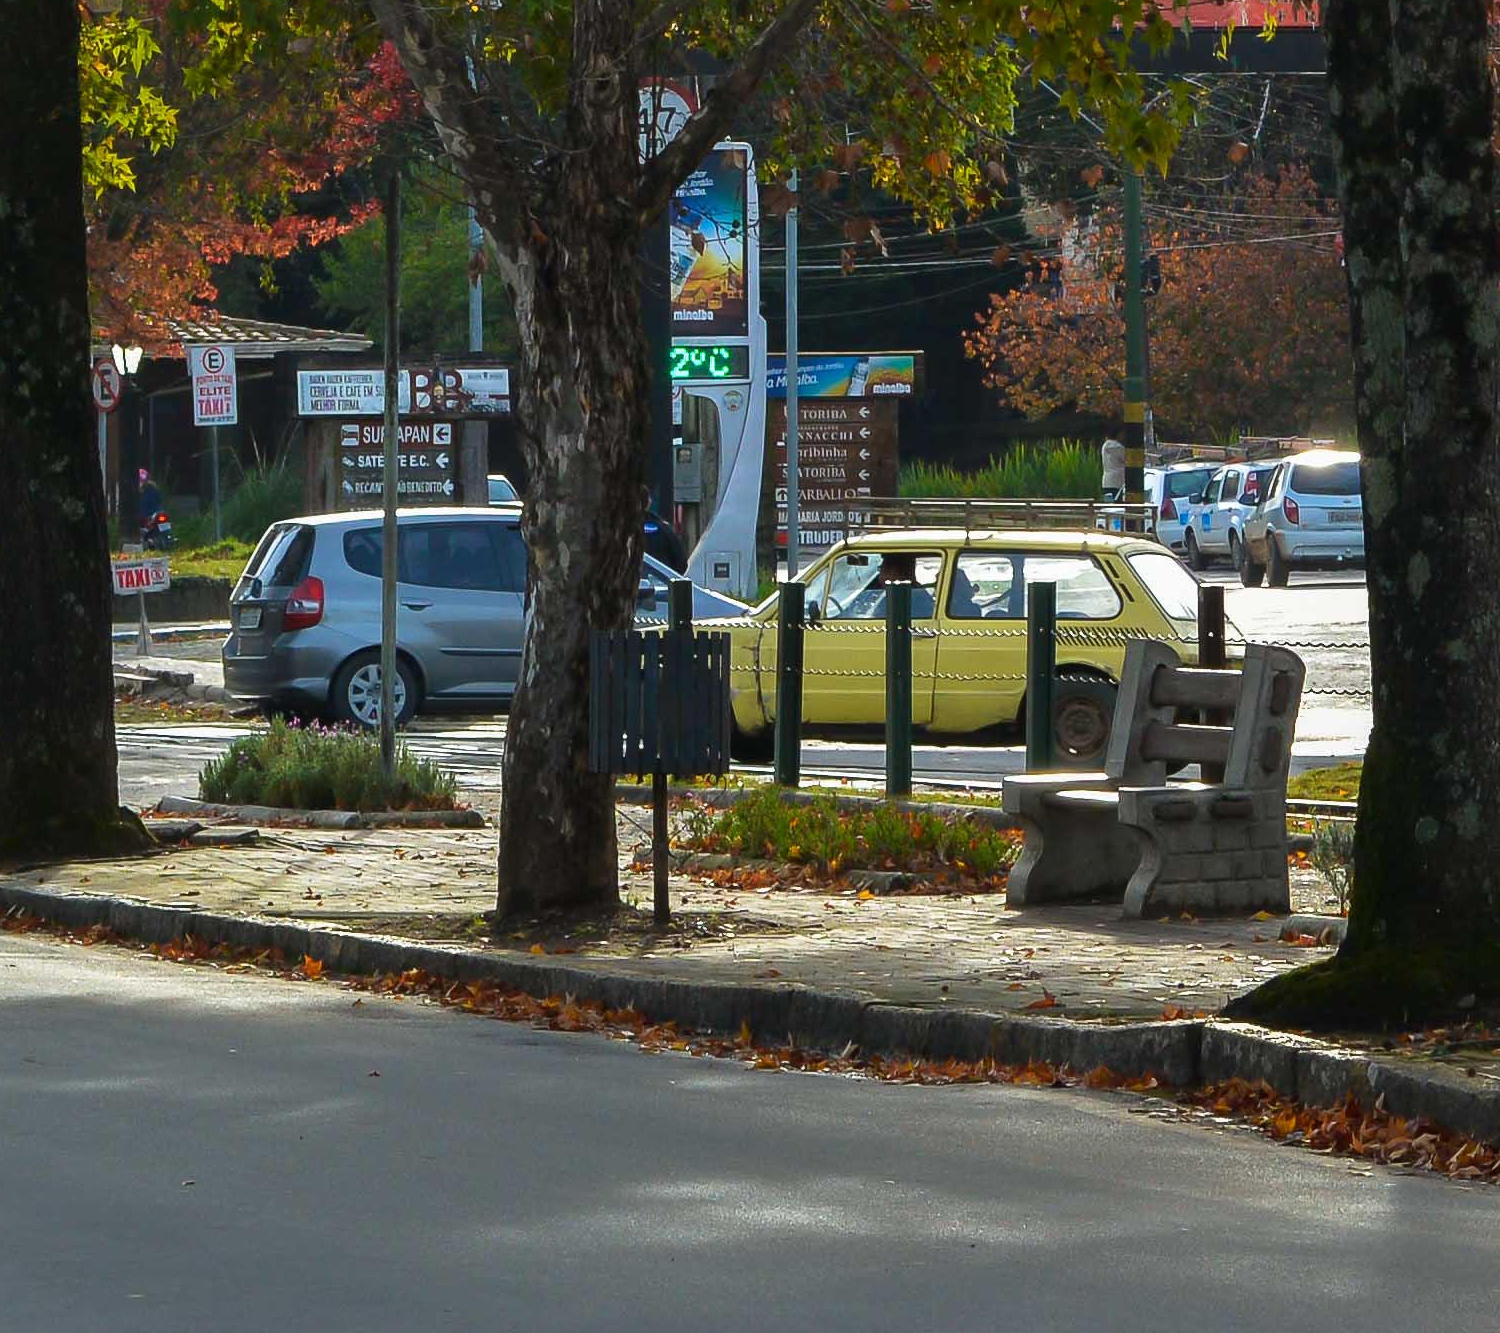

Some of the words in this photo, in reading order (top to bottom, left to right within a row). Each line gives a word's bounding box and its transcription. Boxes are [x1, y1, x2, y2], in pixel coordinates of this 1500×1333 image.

[801, 409, 847, 420] TORIBA
[362, 425, 430, 444] SUAPAN
[798, 488, 857, 501] ARBALLO
[116, 568, 151, 588] TAXI
